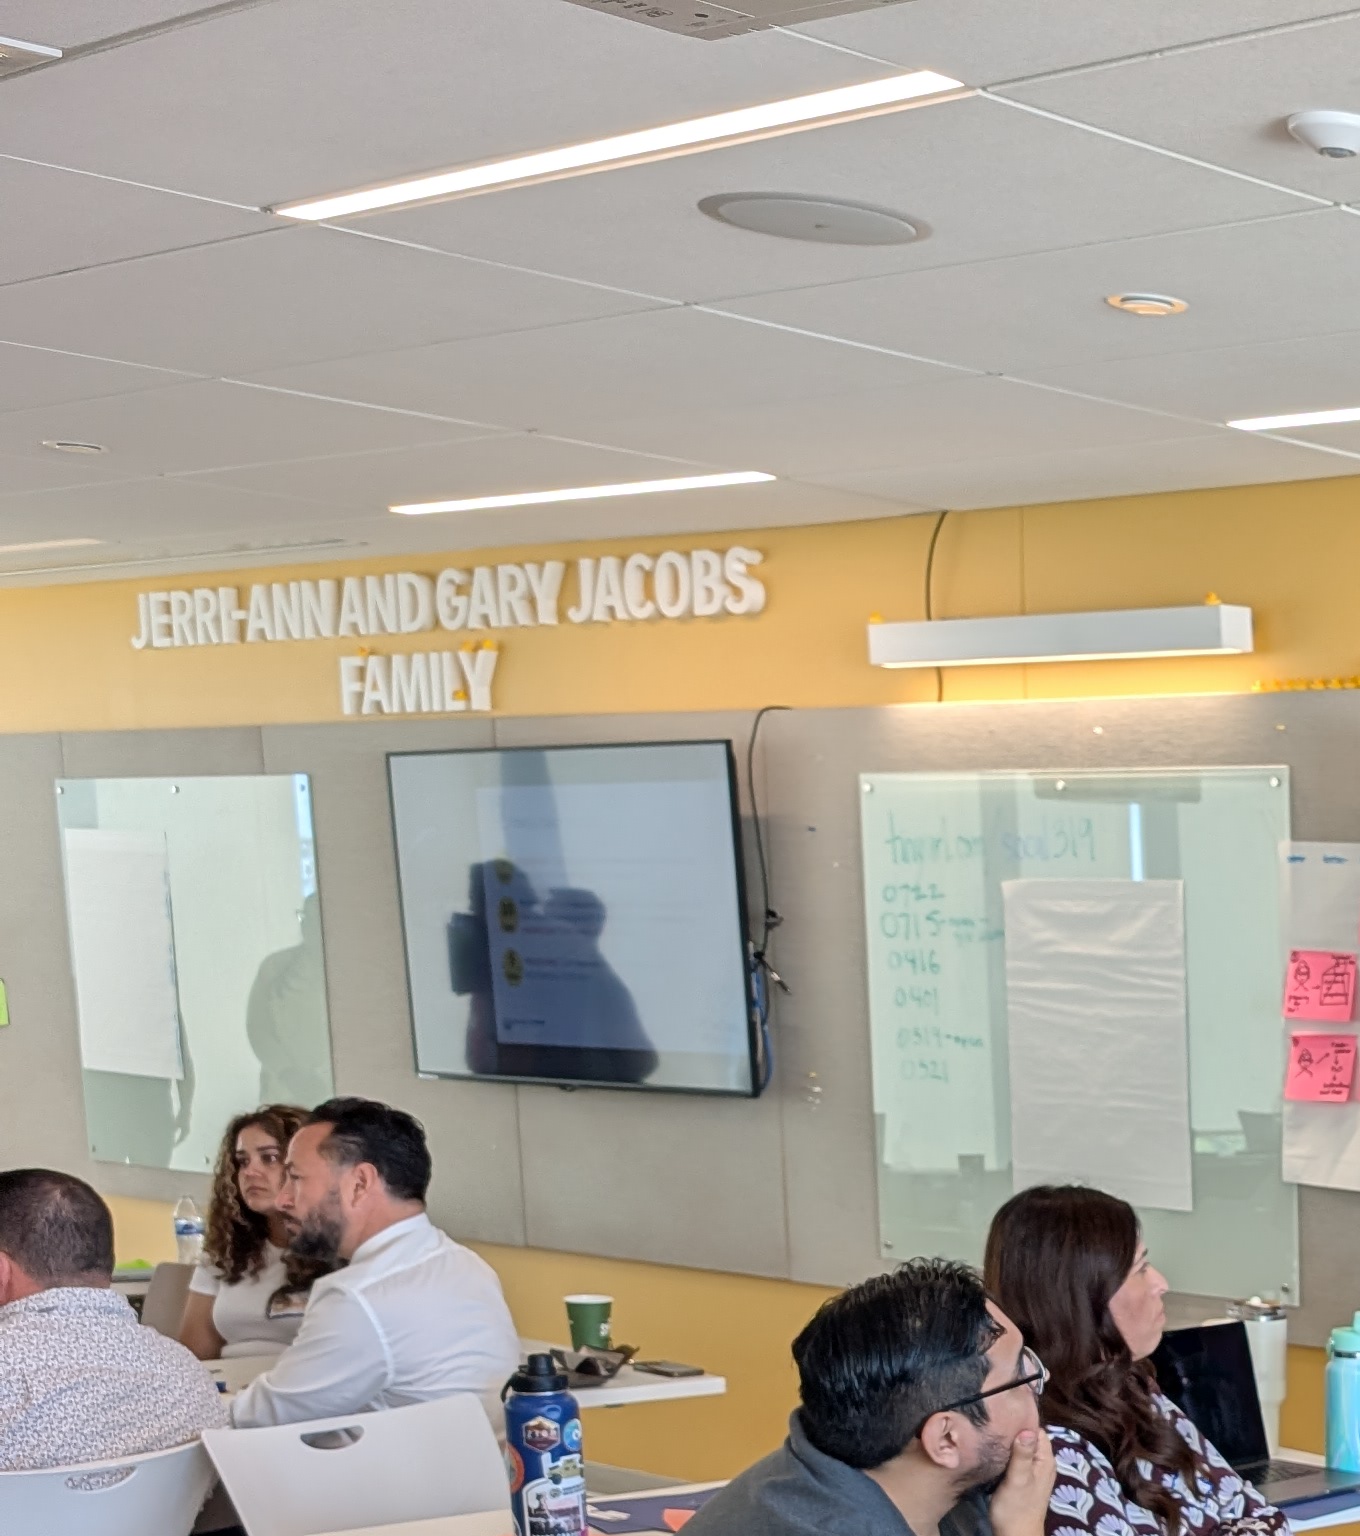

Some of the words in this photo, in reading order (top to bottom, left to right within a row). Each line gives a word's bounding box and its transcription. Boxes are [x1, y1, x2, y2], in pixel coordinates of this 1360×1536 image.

[132, 579, 339, 649] JERRI-ANN
[338, 571, 434, 637] AND
[436, 560, 566, 631] GARY
[567, 547, 766, 623] JACOBS
[340, 650, 498, 715] FAMILY
